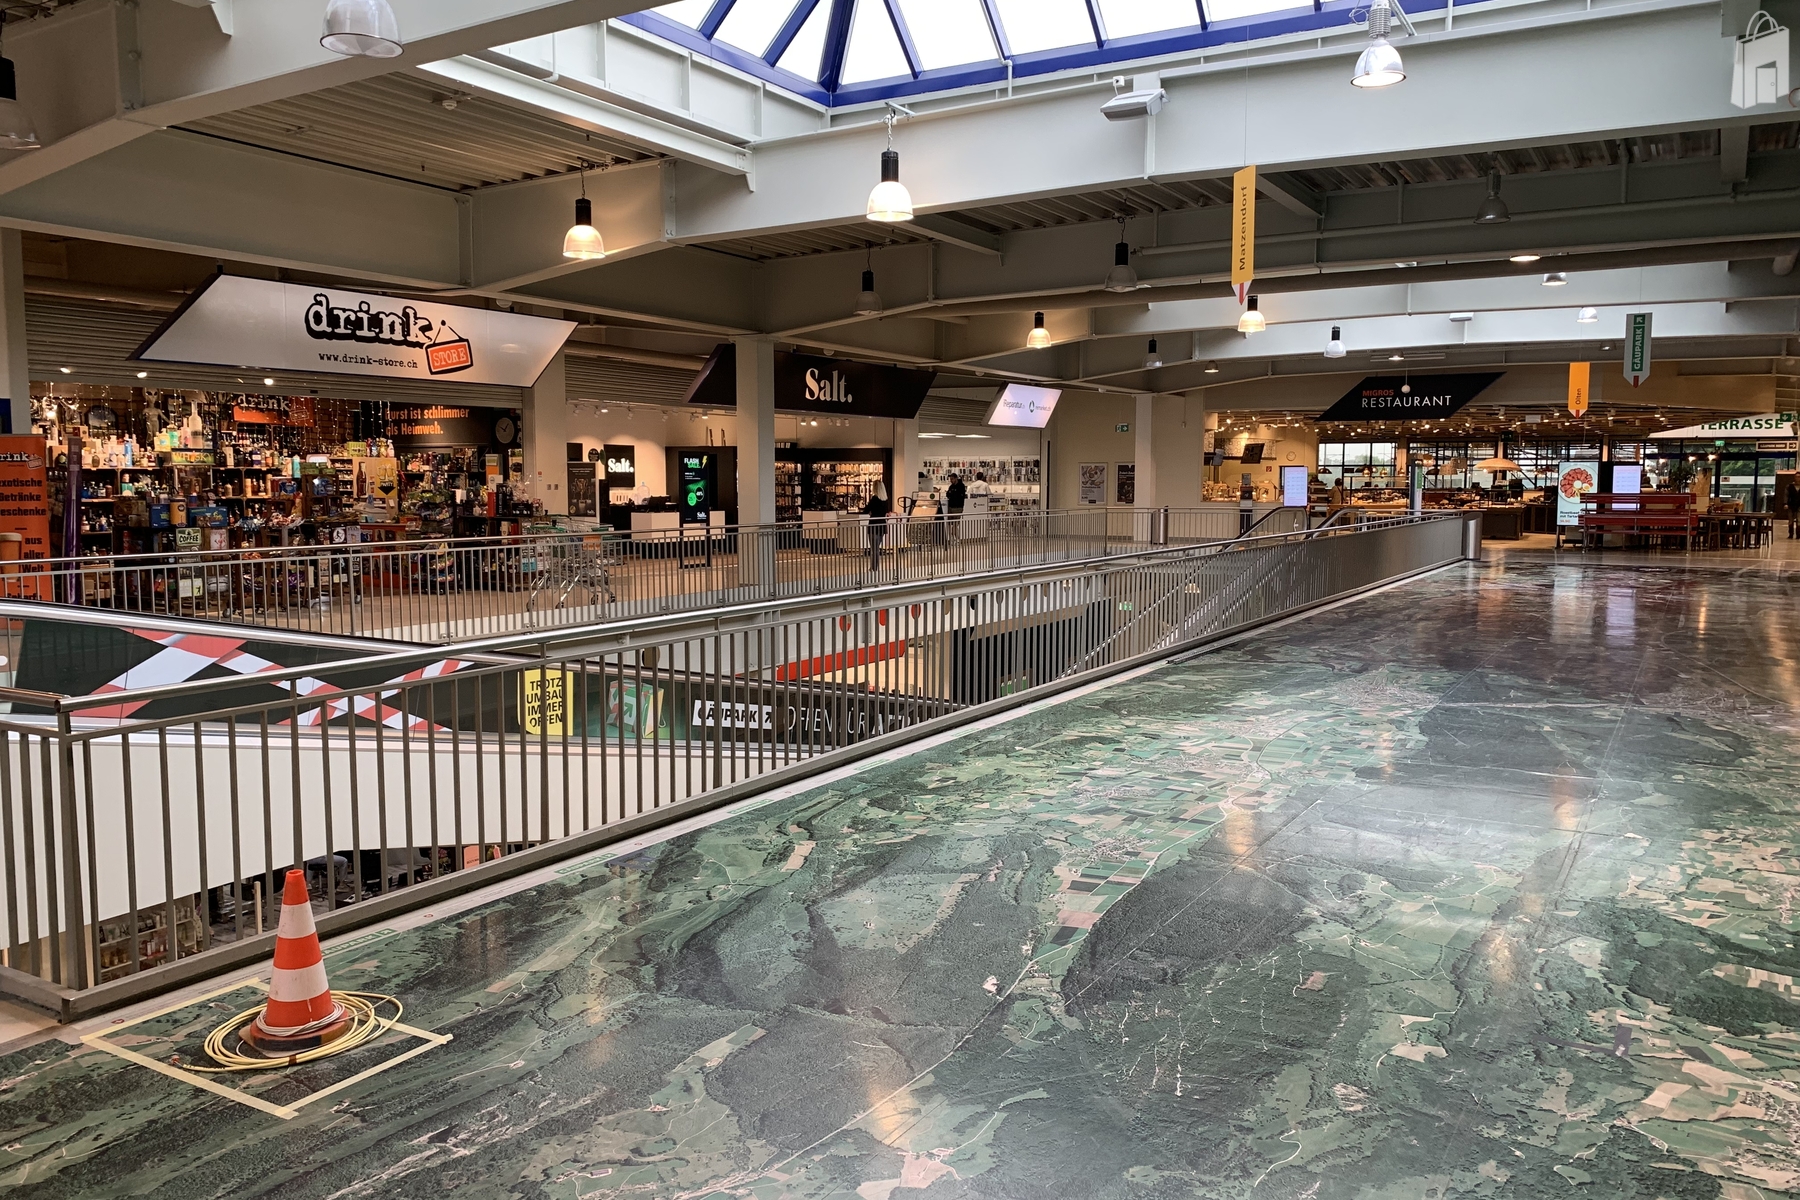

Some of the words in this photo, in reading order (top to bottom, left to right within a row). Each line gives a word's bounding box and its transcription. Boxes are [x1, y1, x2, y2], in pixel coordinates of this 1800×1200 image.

[1239, 186, 1247, 270] Matzendorf
[305, 293, 434, 349] drink
[1634, 328, 1643, 370] GÄUPARK
[318, 353, 418, 369] www.drink-store.ch
[432, 347, 467, 367] STORE
[805, 368, 853, 403] Salt.
[1362, 389, 1394, 397] MIGROS
[1574, 387, 1582, 405] Olten
[237, 393, 290, 411] drink
[1361, 395, 1452, 408] RESTAURANT
[410, 407, 421, 419] ist
[423, 405, 470, 419] schlimmer
[401, 421, 444, 435] Heimweh.
[0, 452, 29, 461] rink
[608, 458, 634, 472] Salt.
[0, 478, 42, 487] xotische
[0, 507, 46, 516] eschenke
[179, 535, 199, 543] COFFEE
[24, 550, 45, 559] aller
[22, 564, 44, 573] Welt
[530, 677, 562, 691] TROTZ
[698, 704, 757, 722] ÄPARK
